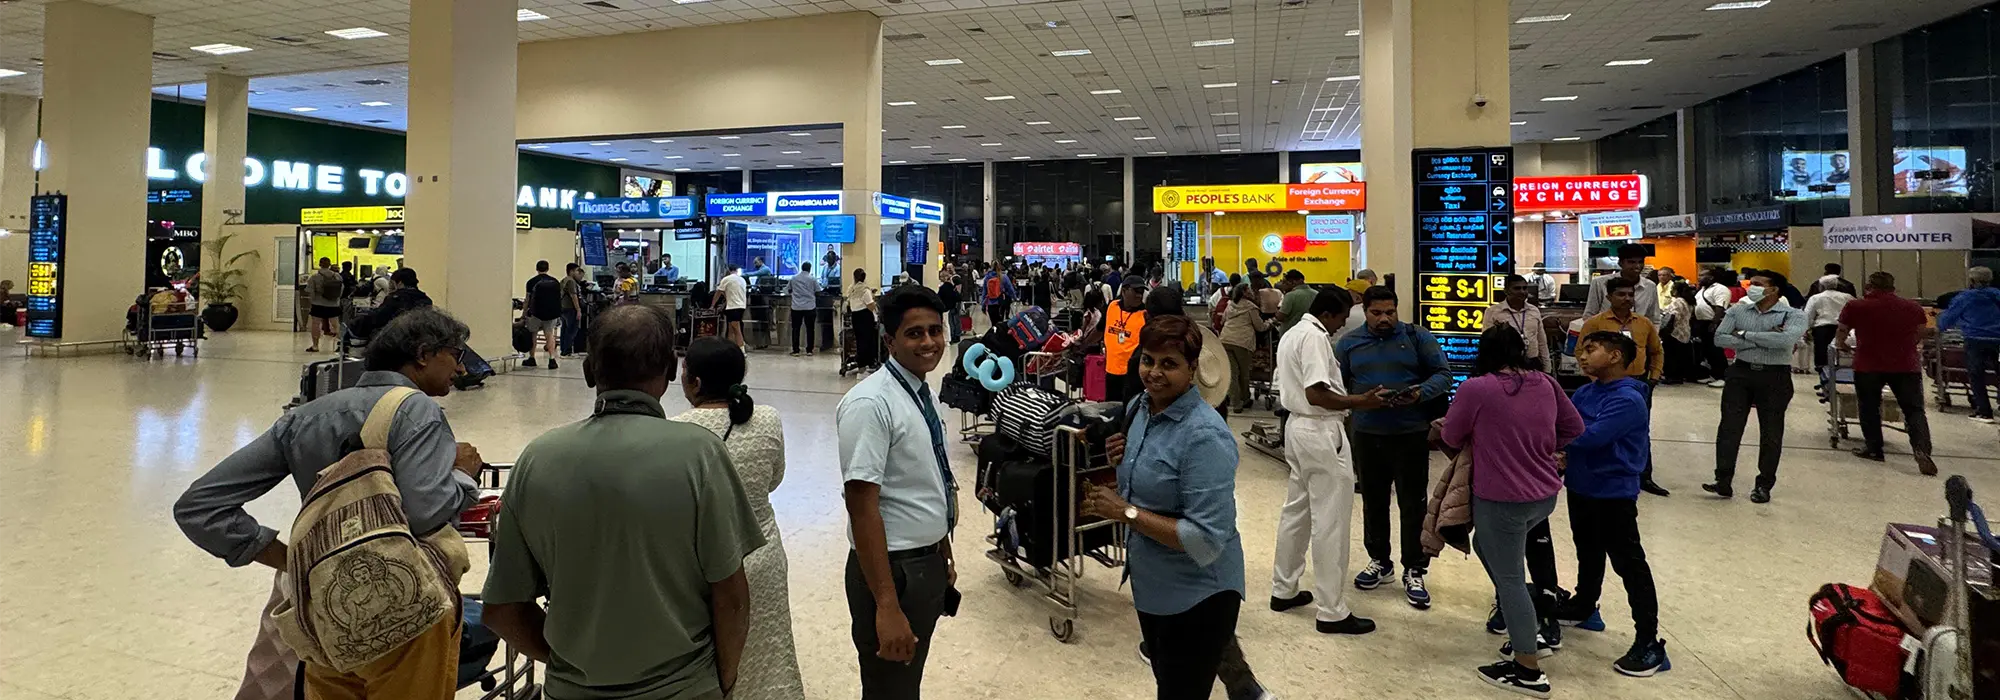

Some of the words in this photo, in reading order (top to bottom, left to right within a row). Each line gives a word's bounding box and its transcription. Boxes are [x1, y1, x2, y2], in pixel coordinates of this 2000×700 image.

[359, 169, 407, 197] TO
[1513, 182, 1559, 191] OREIGN
[1565, 180, 1637, 190] CURRENCY
[1289, 187, 1321, 196] Foreign
[1322, 187, 1360, 196] Currency
[1519, 190, 1638, 202] XCHANGE
[517, 185, 596, 210] ANK
[710, 197, 734, 205] FOREIGN
[823, 198, 839, 206] BANK
[1186, 193, 1239, 204] PEOPLE'S
[1242, 193, 1275, 204] BANK
[1304, 197, 1345, 206] Exchange
[577, 201, 620, 214] Thomas
[621, 200, 650, 213] Cook
[387, 210, 403, 219] BOC
[173, 229, 198, 237] MBO
[1829, 234, 1873, 243] STOPOVER
[1875, 233, 1953, 242] COUNTER
[1033, 244, 1054, 253] airtel
[1456, 278, 1484, 299] S-1
[1457, 308, 1483, 329] S-2
